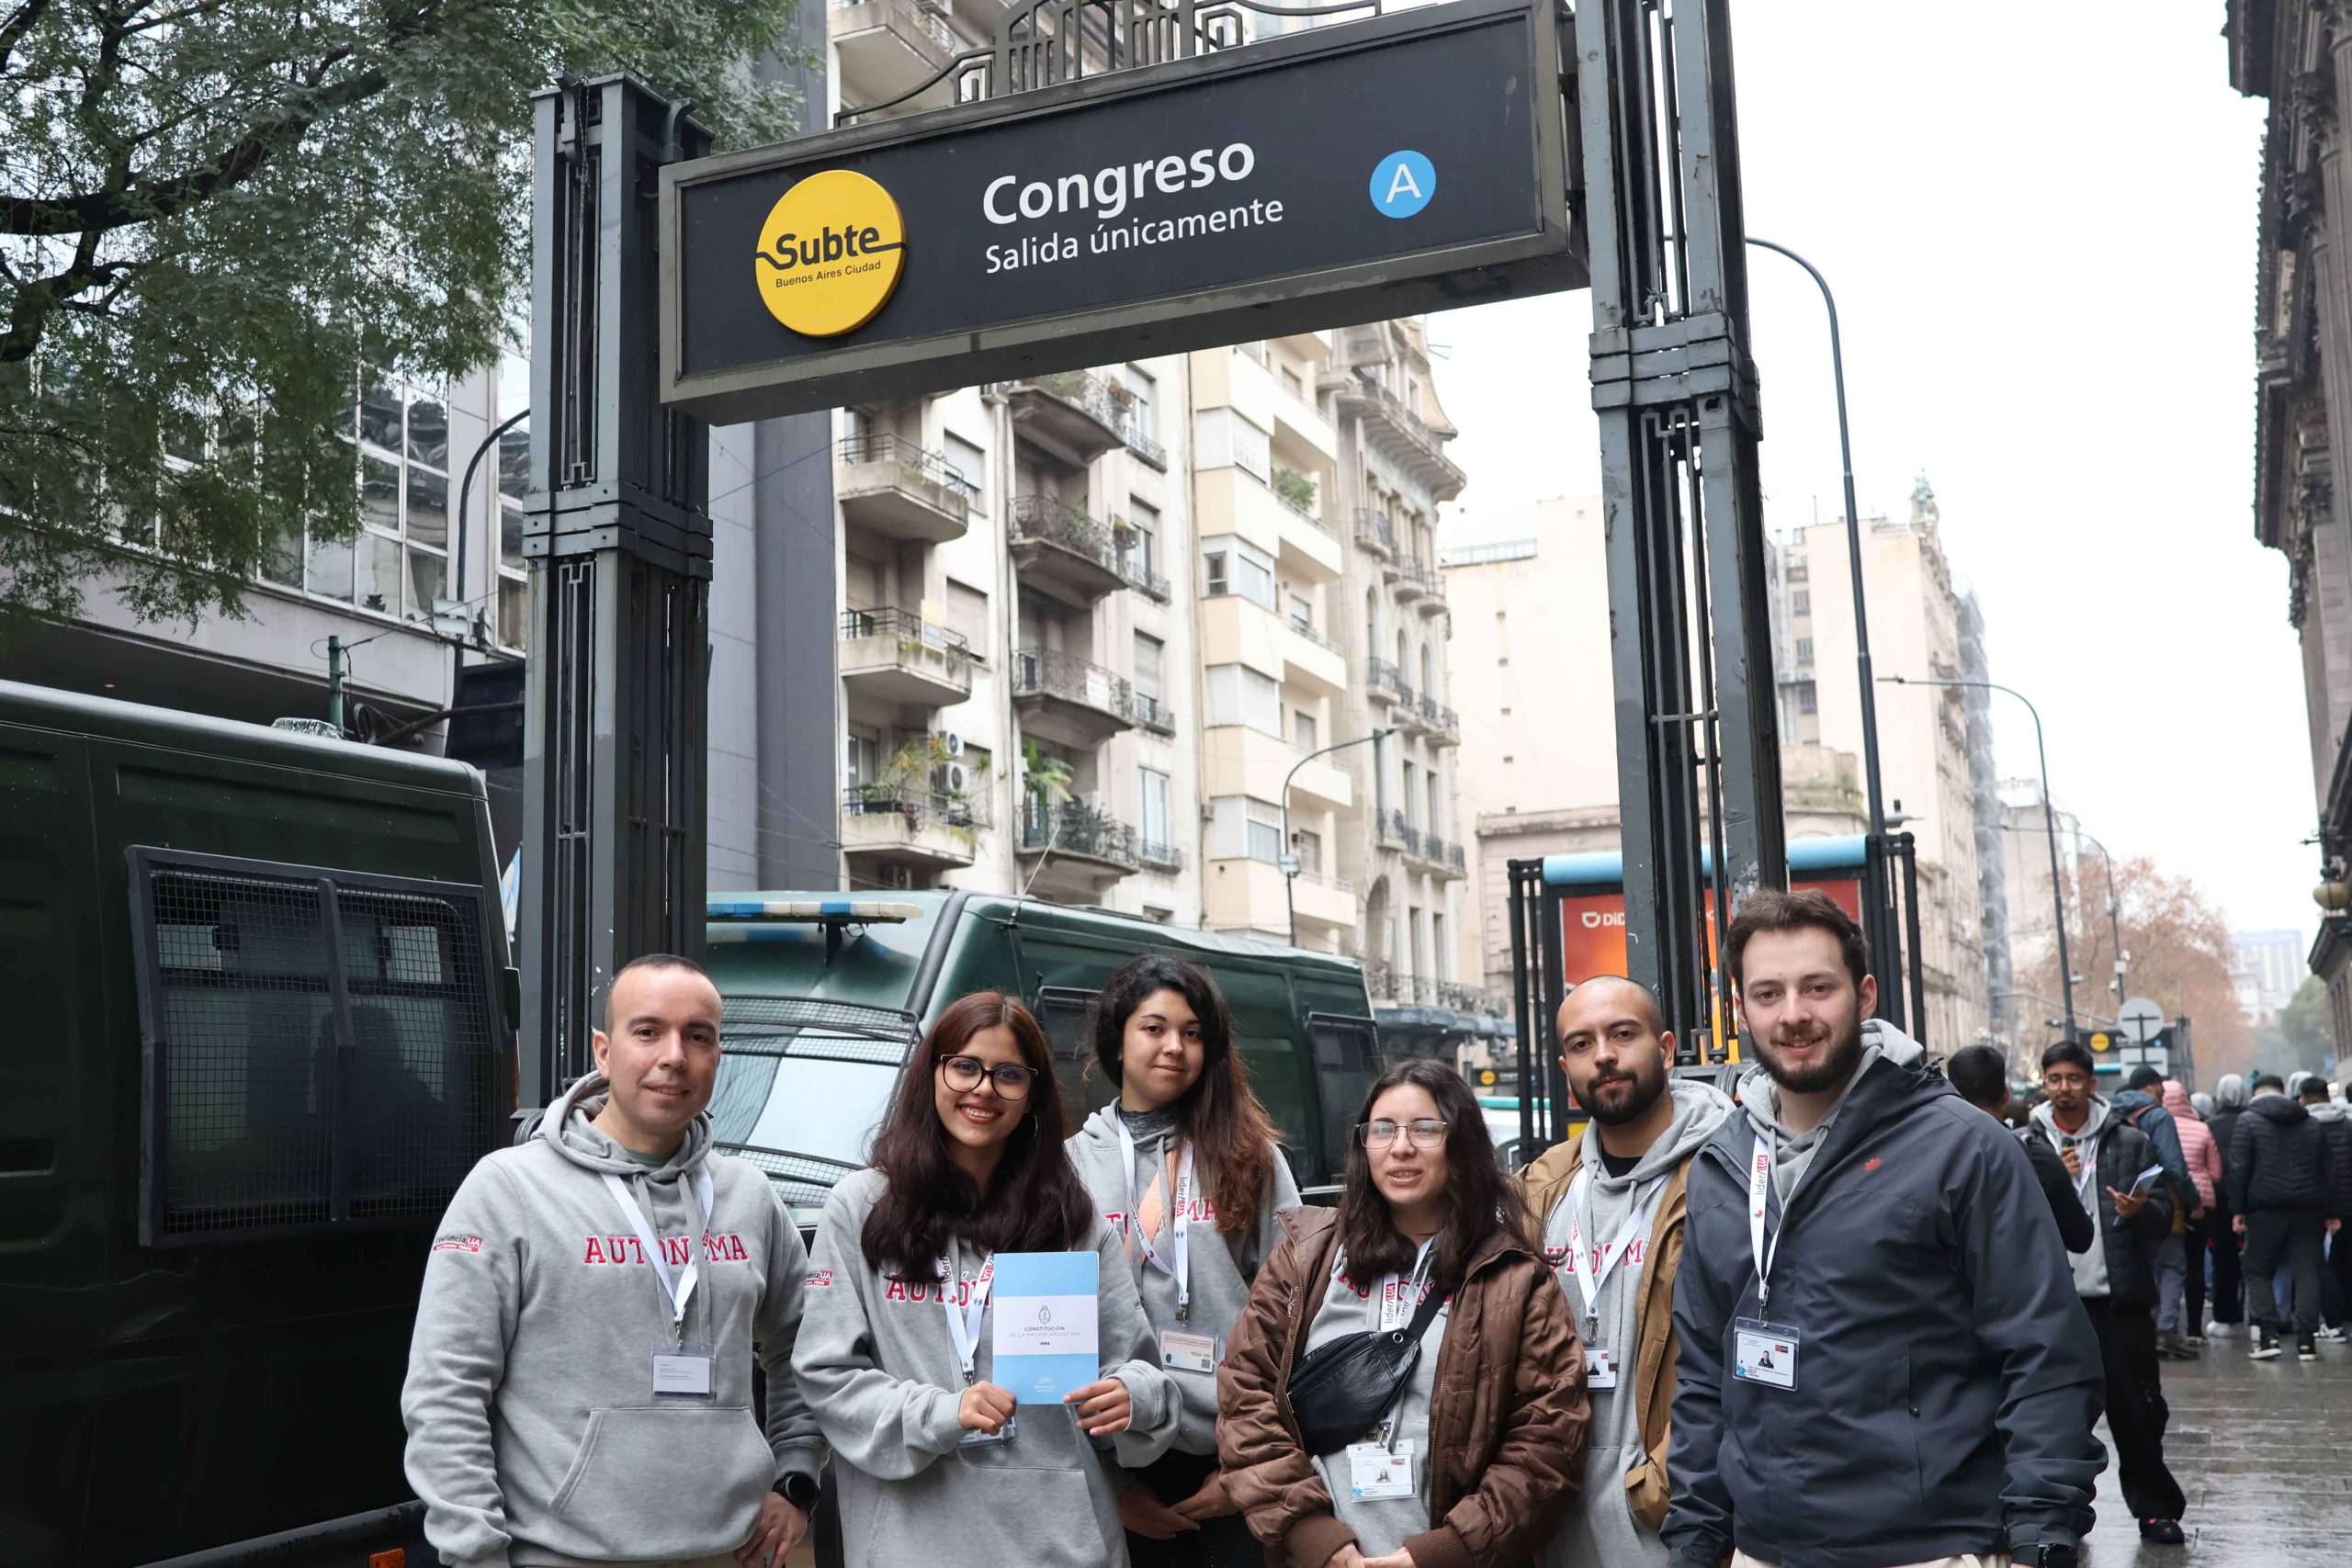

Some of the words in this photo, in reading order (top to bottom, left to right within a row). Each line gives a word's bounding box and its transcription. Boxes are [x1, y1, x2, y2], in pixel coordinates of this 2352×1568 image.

[982, 142, 1255, 225] Congreso
[1385, 164, 1421, 203] A
[775, 224, 880, 270] Subte
[985, 231, 1079, 274] Salida
[1090, 198, 1283, 254] únicamente
[775, 273, 813, 288] Buenos
[816, 268, 842, 280] Aires
[845, 260, 881, 275] Ciudad
